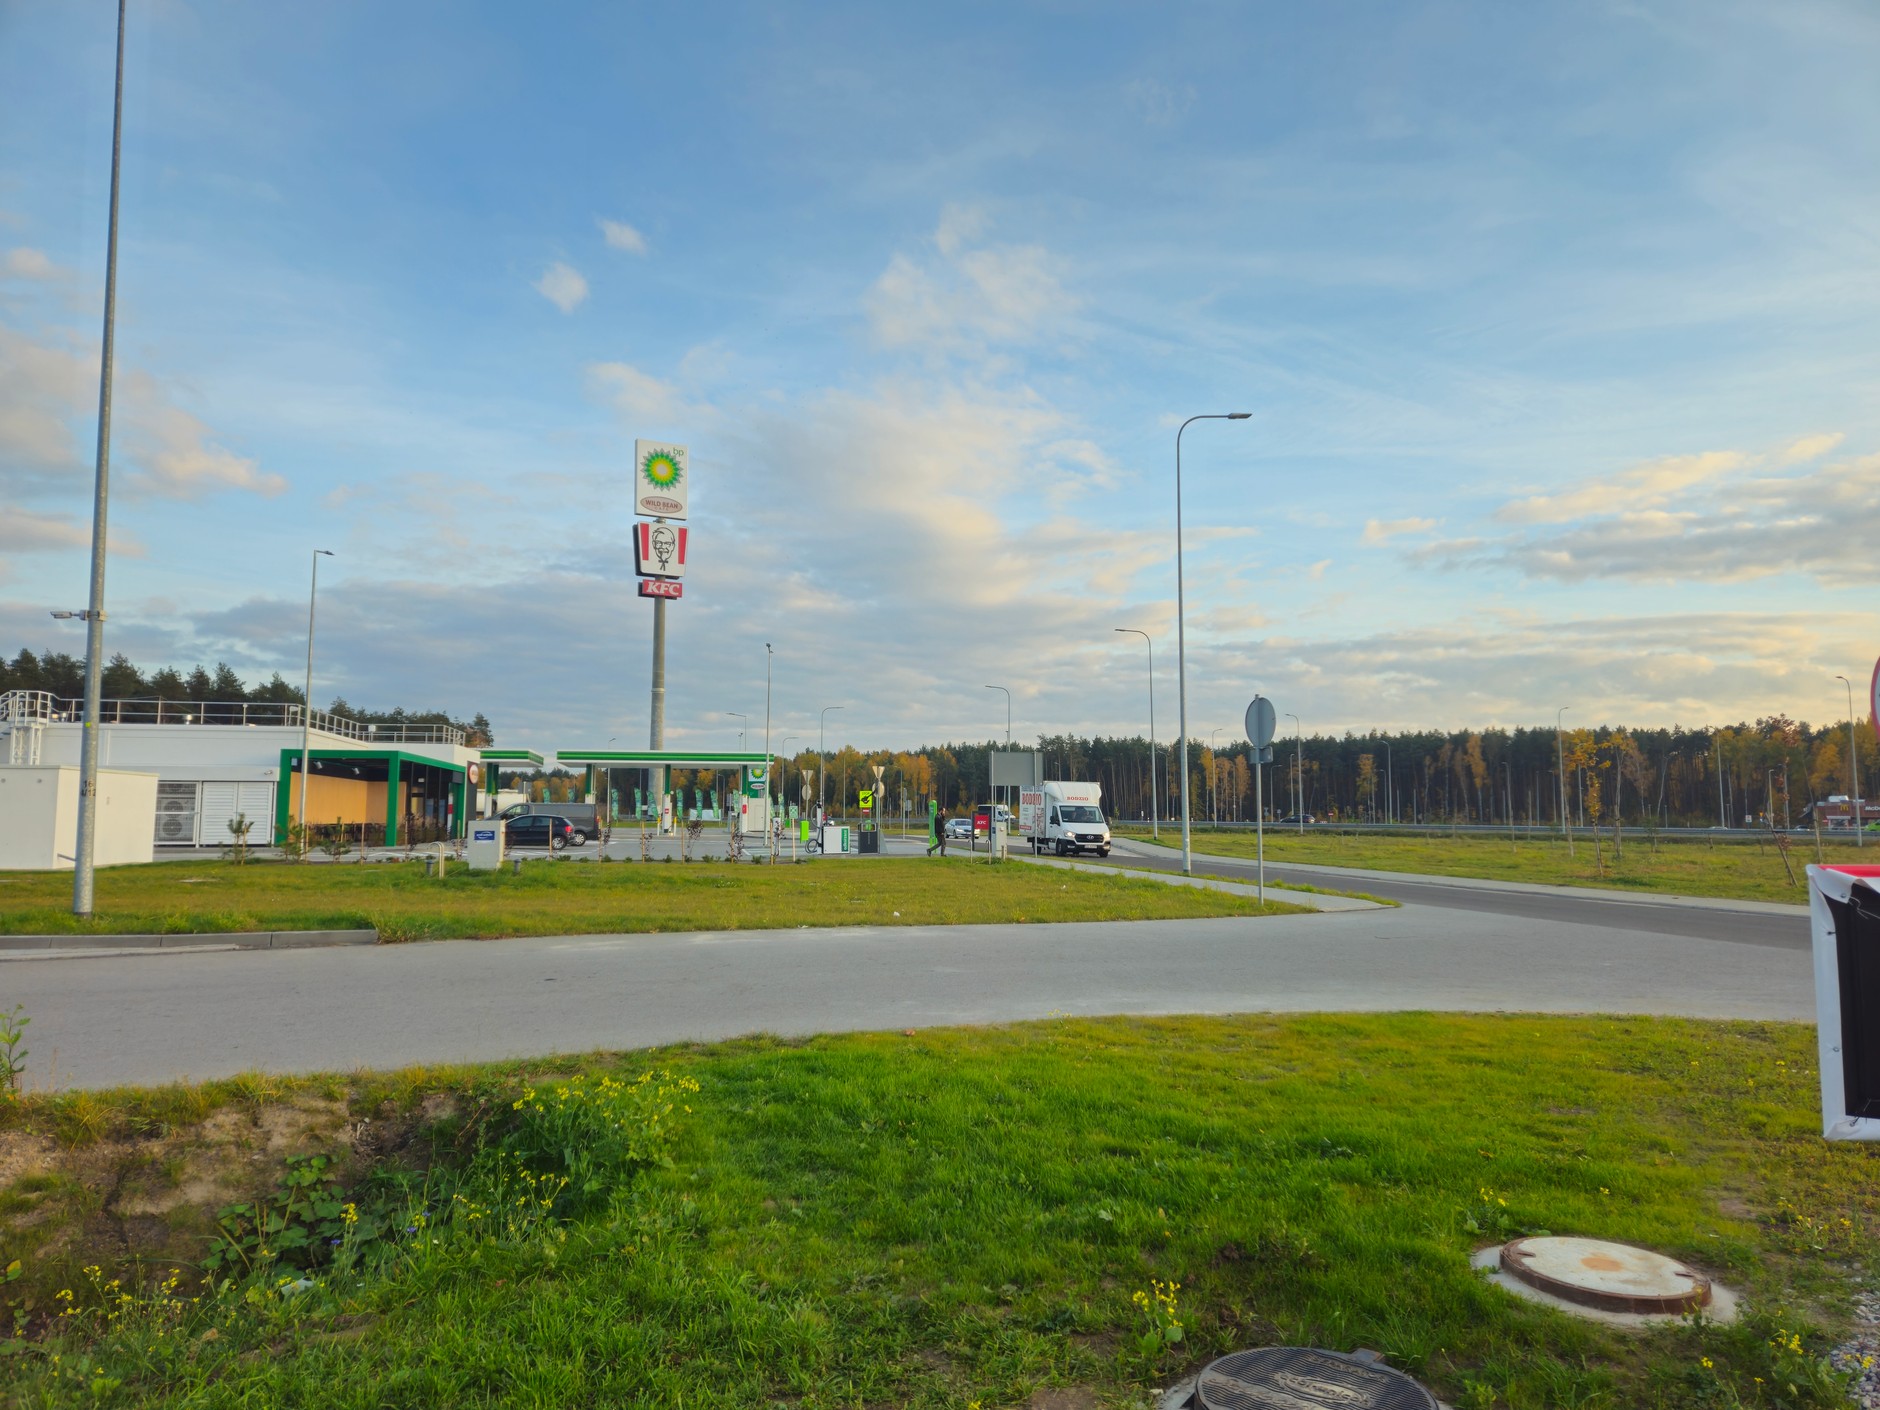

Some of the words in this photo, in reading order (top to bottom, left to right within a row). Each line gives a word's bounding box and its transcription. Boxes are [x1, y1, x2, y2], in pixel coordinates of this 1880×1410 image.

[673, 447, 684, 457] bp
[645, 499, 661, 507] WILD
[662, 501, 679, 509] BEAN
[646, 581, 680, 595] KFC
